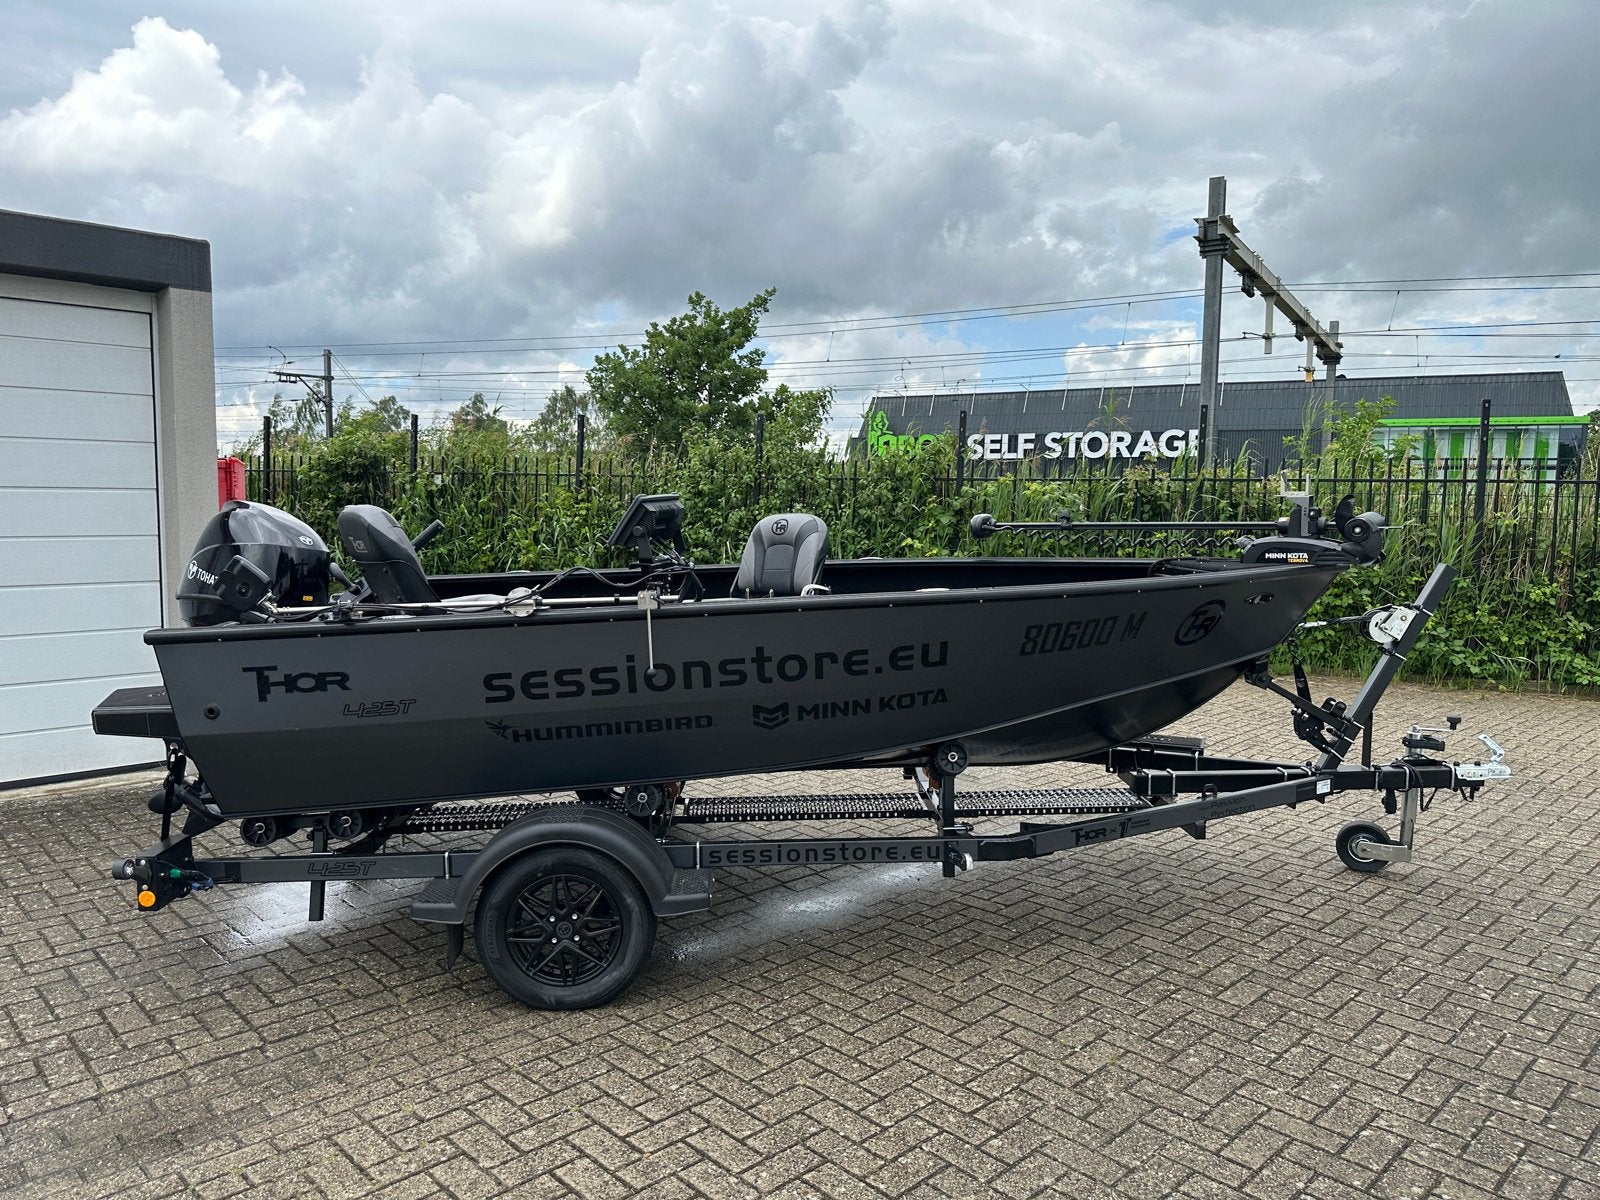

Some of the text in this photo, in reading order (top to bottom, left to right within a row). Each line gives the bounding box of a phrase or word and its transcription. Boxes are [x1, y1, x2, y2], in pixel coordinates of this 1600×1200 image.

[967, 433, 1036, 460] SELF
[196, 568, 219, 585] TOHA
[1019, 610, 1148, 657] 80600 M
[482, 640, 949, 704] sessionstore.eu
[343, 699, 417, 718] 425T
[797, 687, 949, 722] MINN KOTA
[511, 714, 714, 744] HUMMINBIRD
[708, 842, 941, 865] sessionstore.eu
[307, 861, 377, 876] 425T
